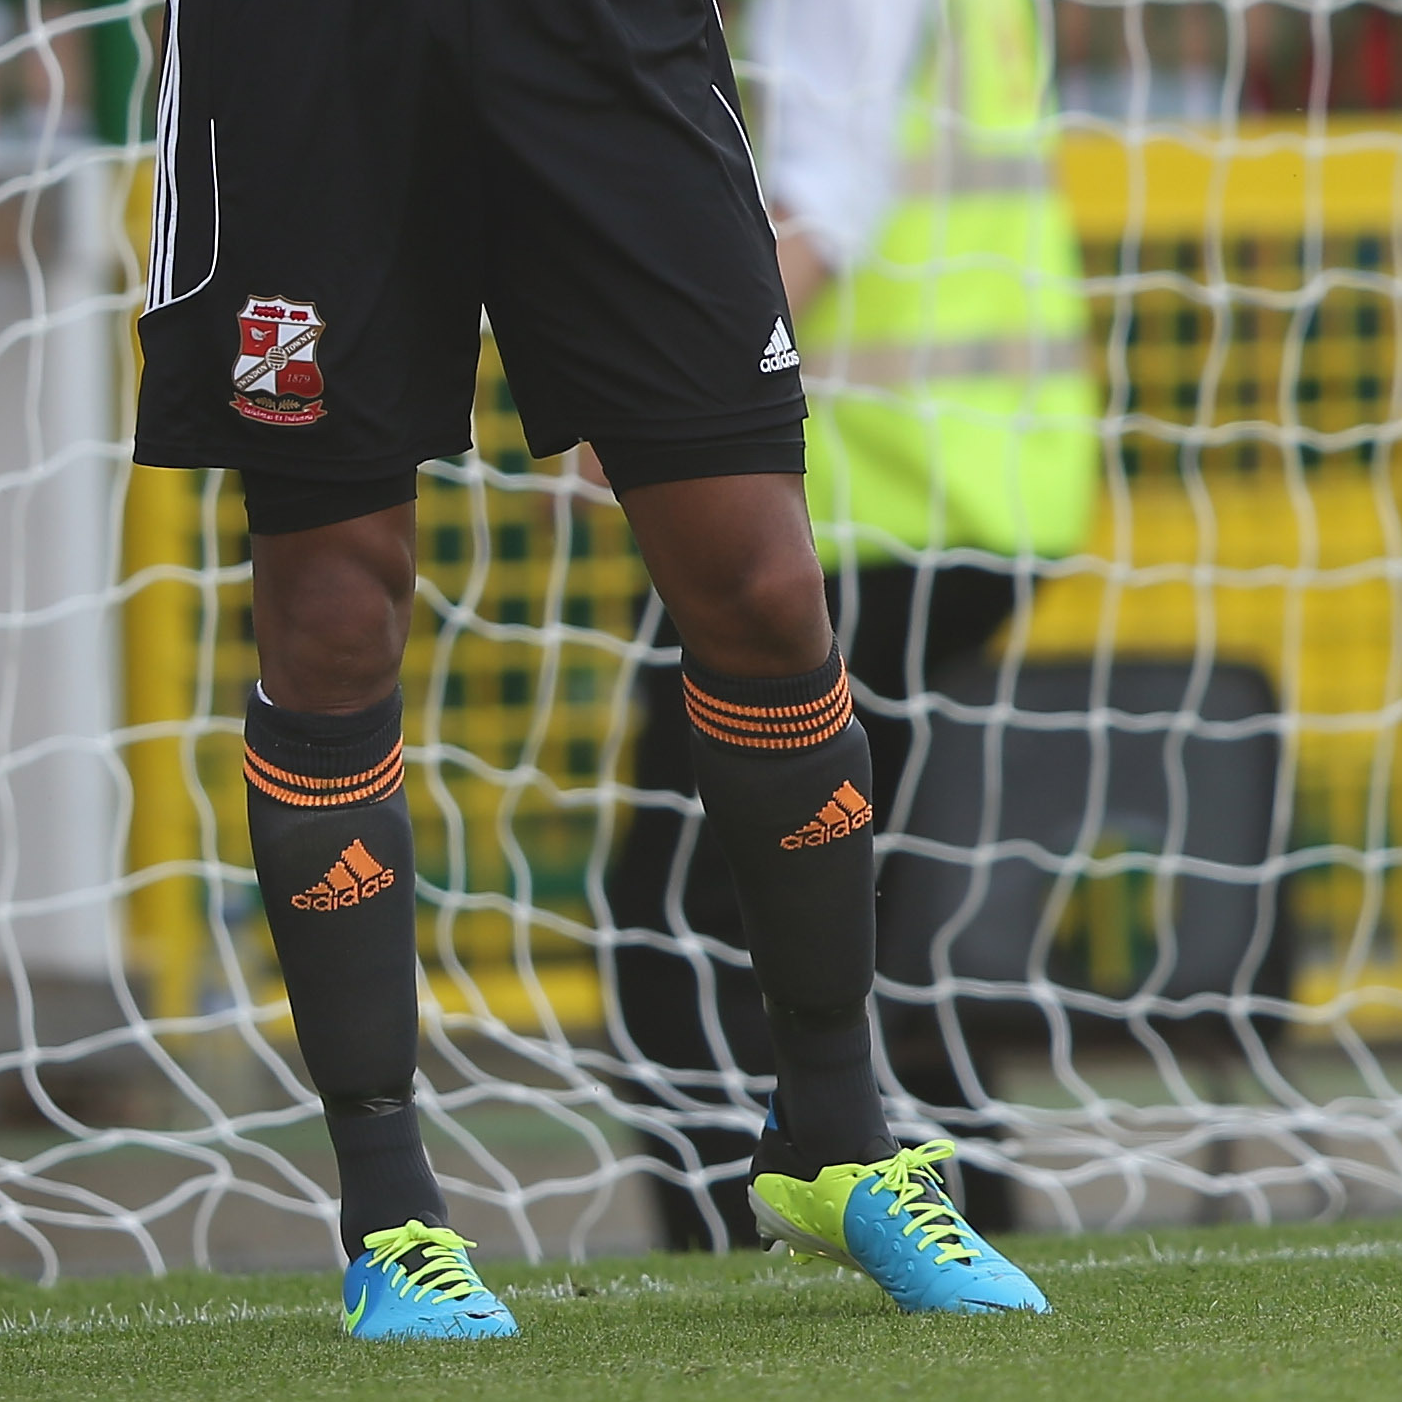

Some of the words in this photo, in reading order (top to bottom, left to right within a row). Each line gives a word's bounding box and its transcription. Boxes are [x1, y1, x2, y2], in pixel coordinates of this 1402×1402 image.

[760, 350, 800, 373] adidas
[236, 363, 268, 390] SWINDON
[287, 374, 311, 383] 1879
[780, 804, 873, 850] adidas
[290, 868, 395, 911] adidas
